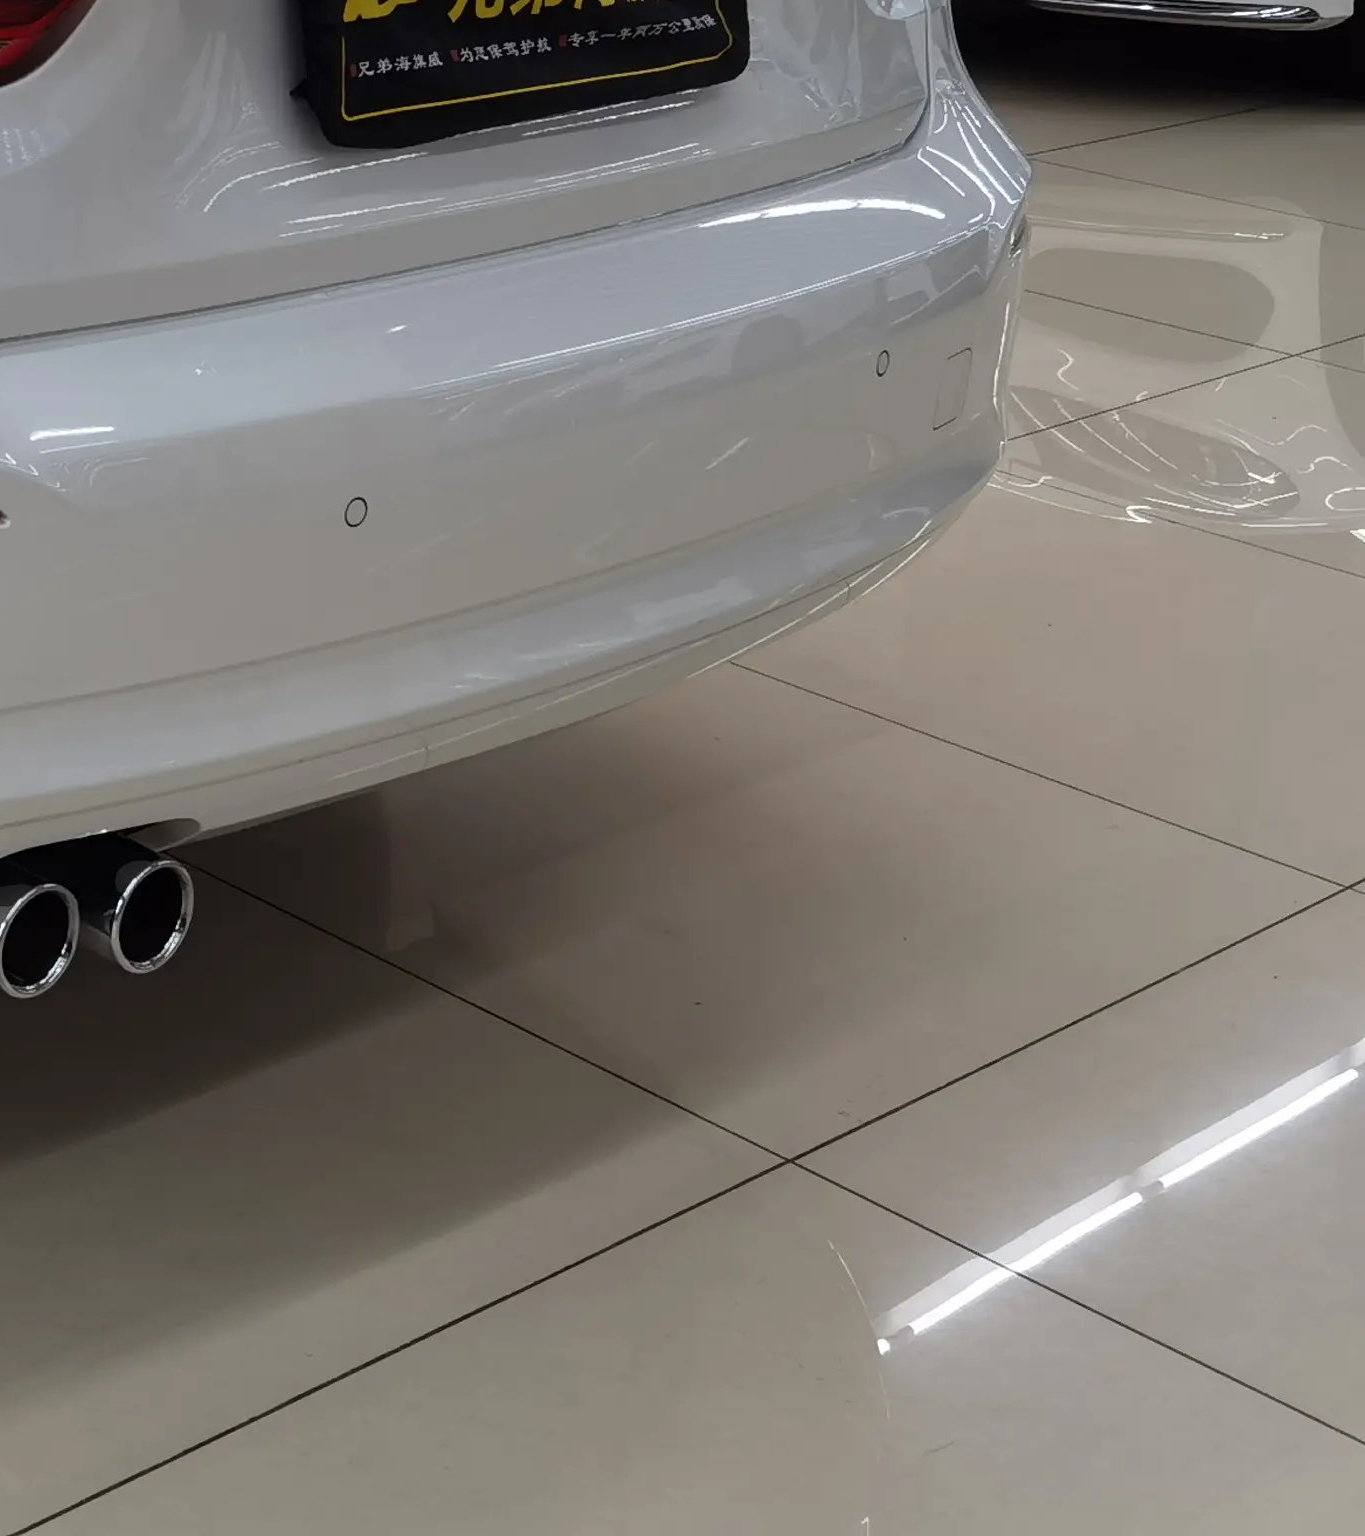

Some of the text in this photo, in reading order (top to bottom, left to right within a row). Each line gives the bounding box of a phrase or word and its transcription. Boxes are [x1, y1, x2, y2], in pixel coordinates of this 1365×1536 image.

[357, 51, 444, 78] 兄弟海旗威
[460, 38, 552, 63] 为您保驾护航
